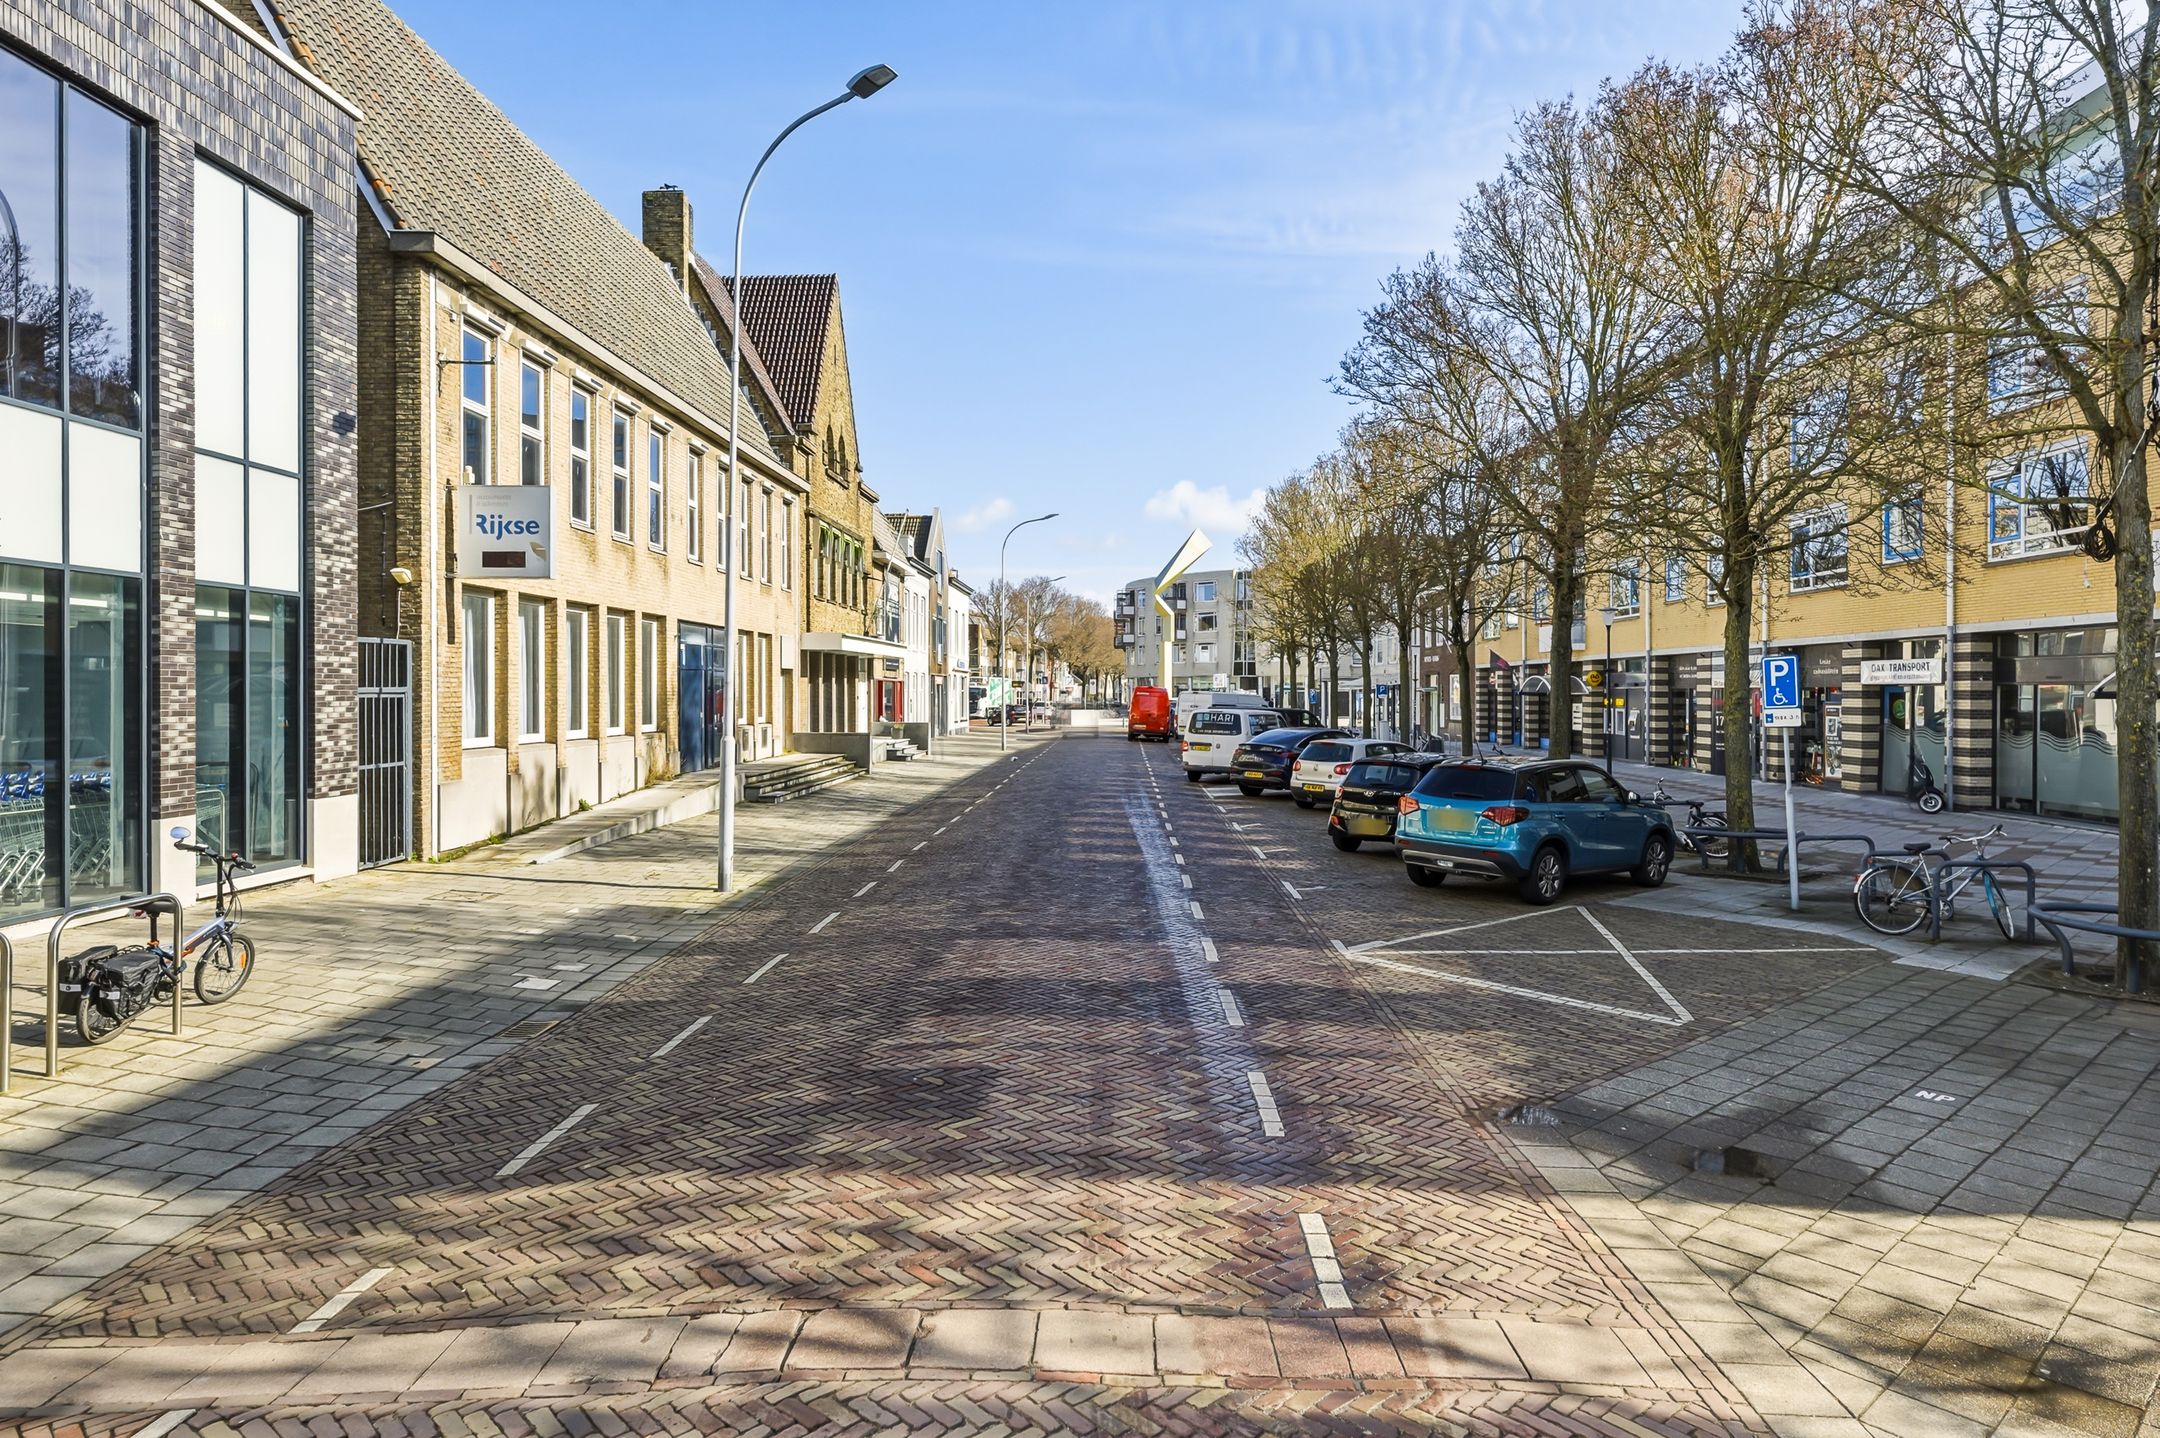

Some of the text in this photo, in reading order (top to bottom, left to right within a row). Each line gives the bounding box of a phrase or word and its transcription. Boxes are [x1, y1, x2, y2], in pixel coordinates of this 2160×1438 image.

[475, 514, 540, 541] Rijkse
[1770, 660, 1789, 687] P
[1889, 661, 1931, 672] TRANSPORT
[1210, 713, 1235, 723] HARI
